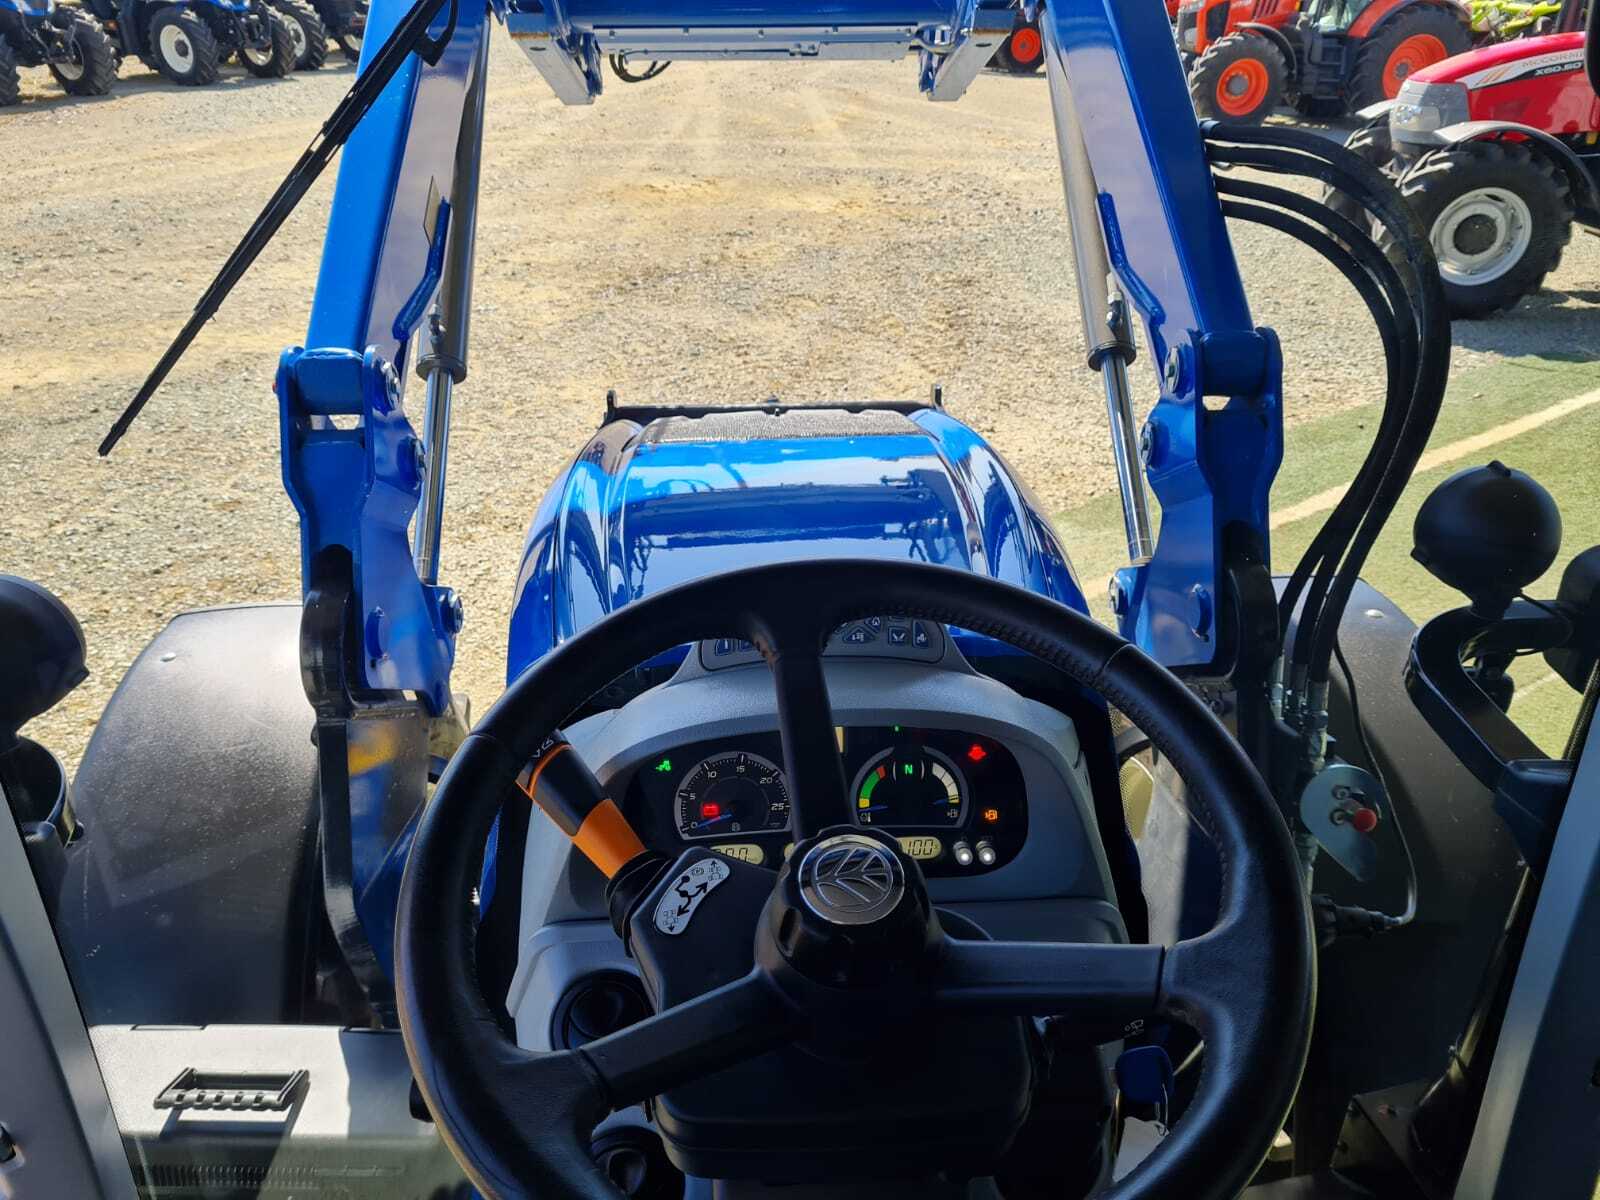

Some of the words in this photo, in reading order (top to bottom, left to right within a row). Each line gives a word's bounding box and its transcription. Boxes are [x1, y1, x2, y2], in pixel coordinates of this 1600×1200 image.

[736, 765, 746, 773] 15
[904, 764, 913, 775] N
[771, 802, 785, 811] 25
[690, 821, 699, 830] 0
